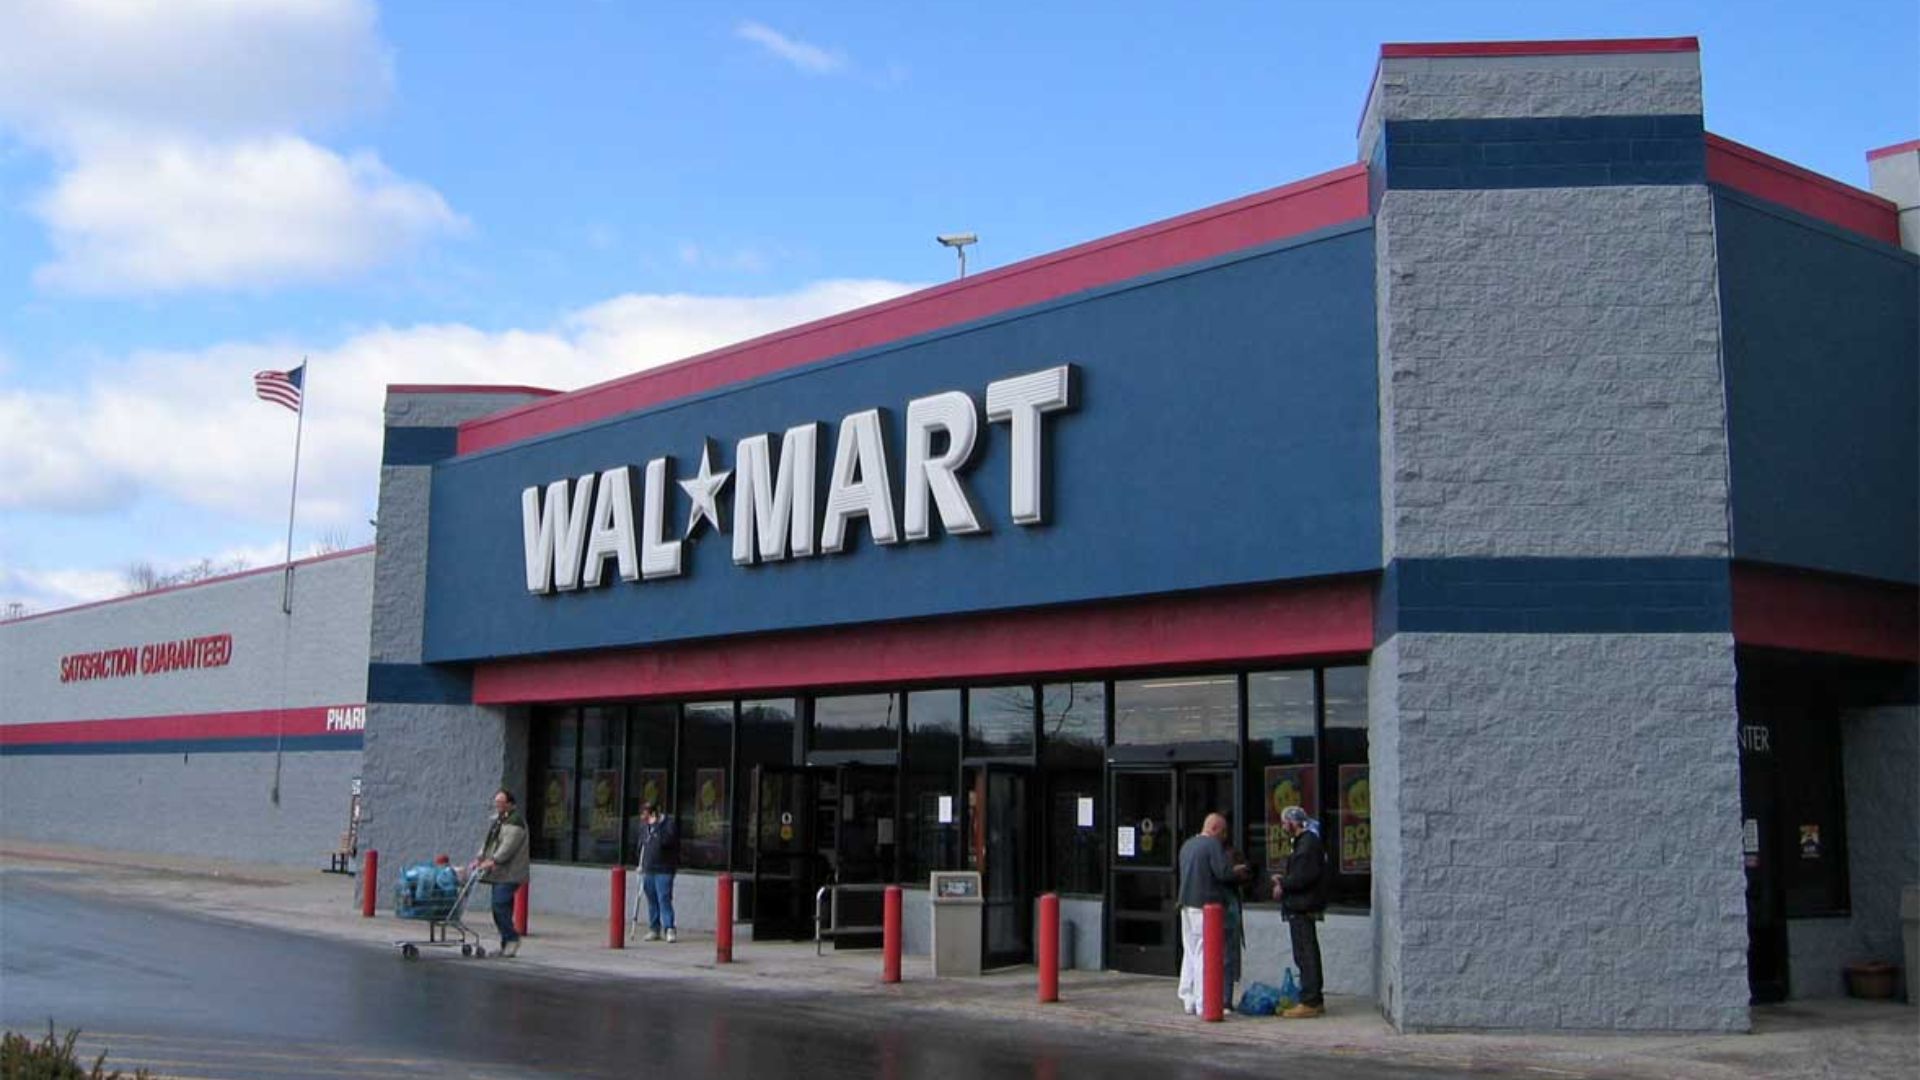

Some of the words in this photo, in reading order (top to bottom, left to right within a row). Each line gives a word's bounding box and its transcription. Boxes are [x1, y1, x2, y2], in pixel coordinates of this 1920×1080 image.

[522, 456, 683, 594] WAL
[732, 363, 1079, 566] MART
[60, 647, 138, 683] SATISFACTION
[141, 633, 232, 676] GUARANTEED
